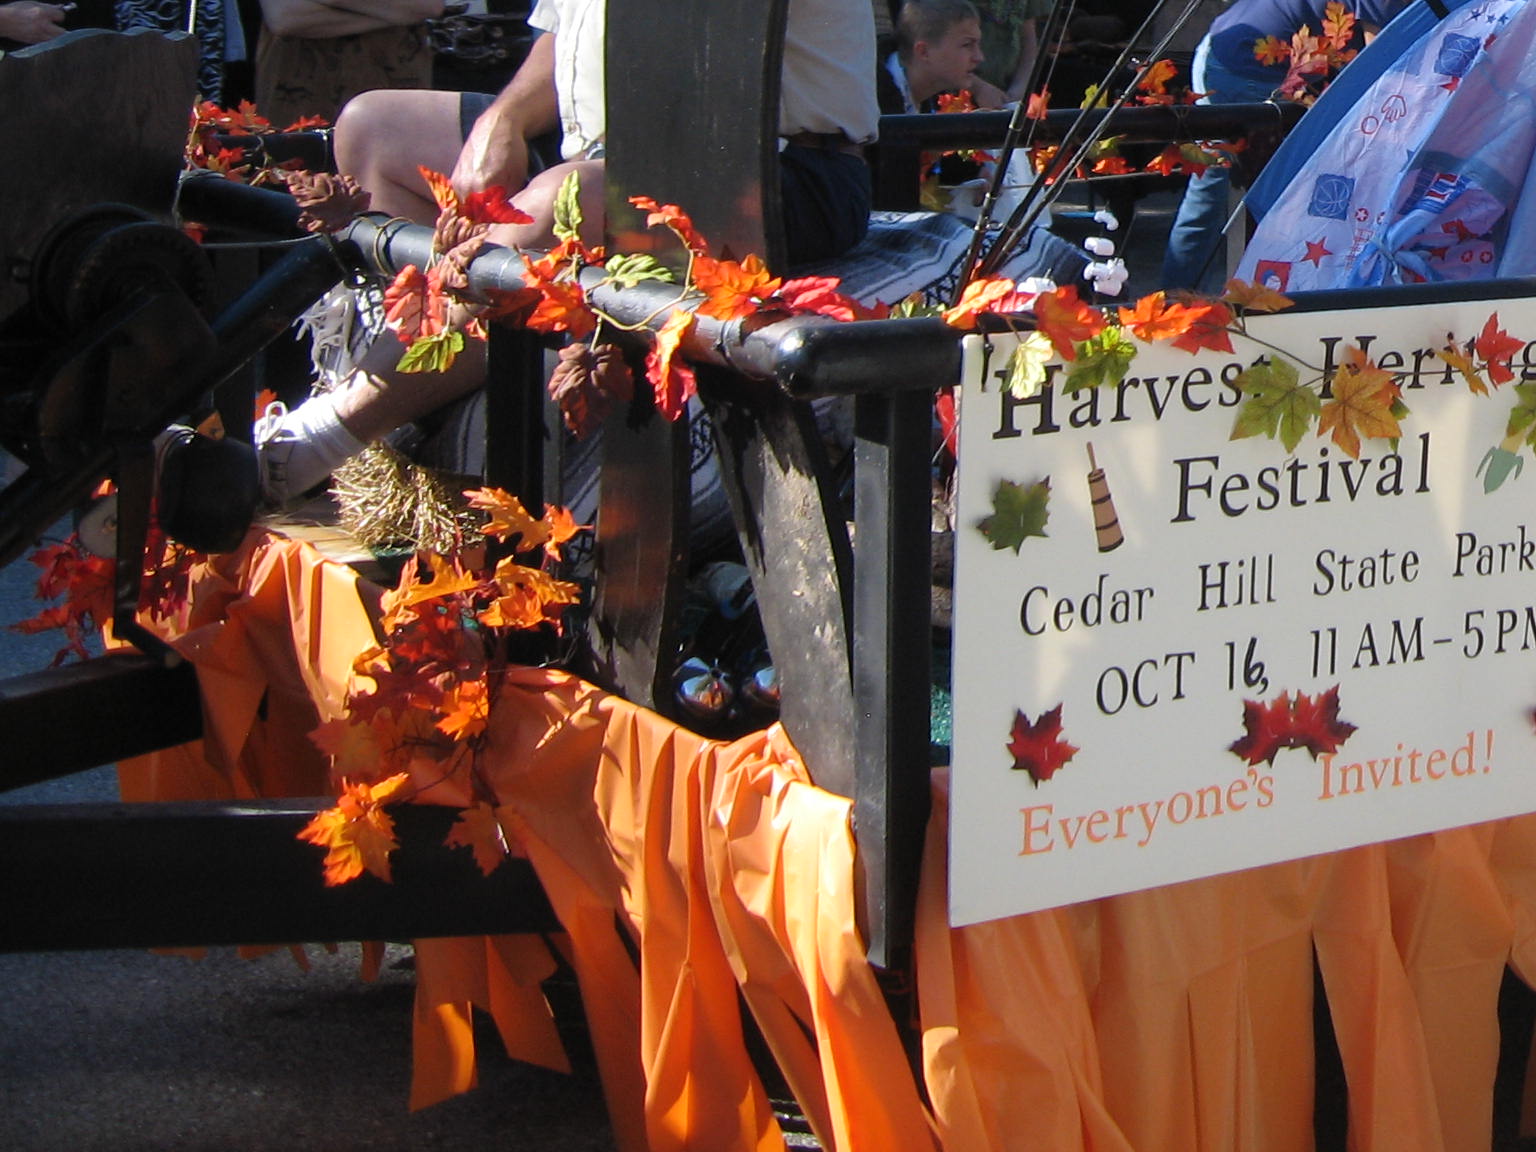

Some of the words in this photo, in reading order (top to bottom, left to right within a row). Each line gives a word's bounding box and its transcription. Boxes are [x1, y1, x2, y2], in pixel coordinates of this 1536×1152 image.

[1170, 433, 1431, 523] Festival
[1020, 574, 1155, 636] Cedar
[1197, 553, 1277, 611] Hill
[1313, 547, 1420, 596] State
[1453, 525, 1536, 578] Park
[1097, 652, 1196, 716] OCT
[1317, 730, 1495, 801] Invited!
